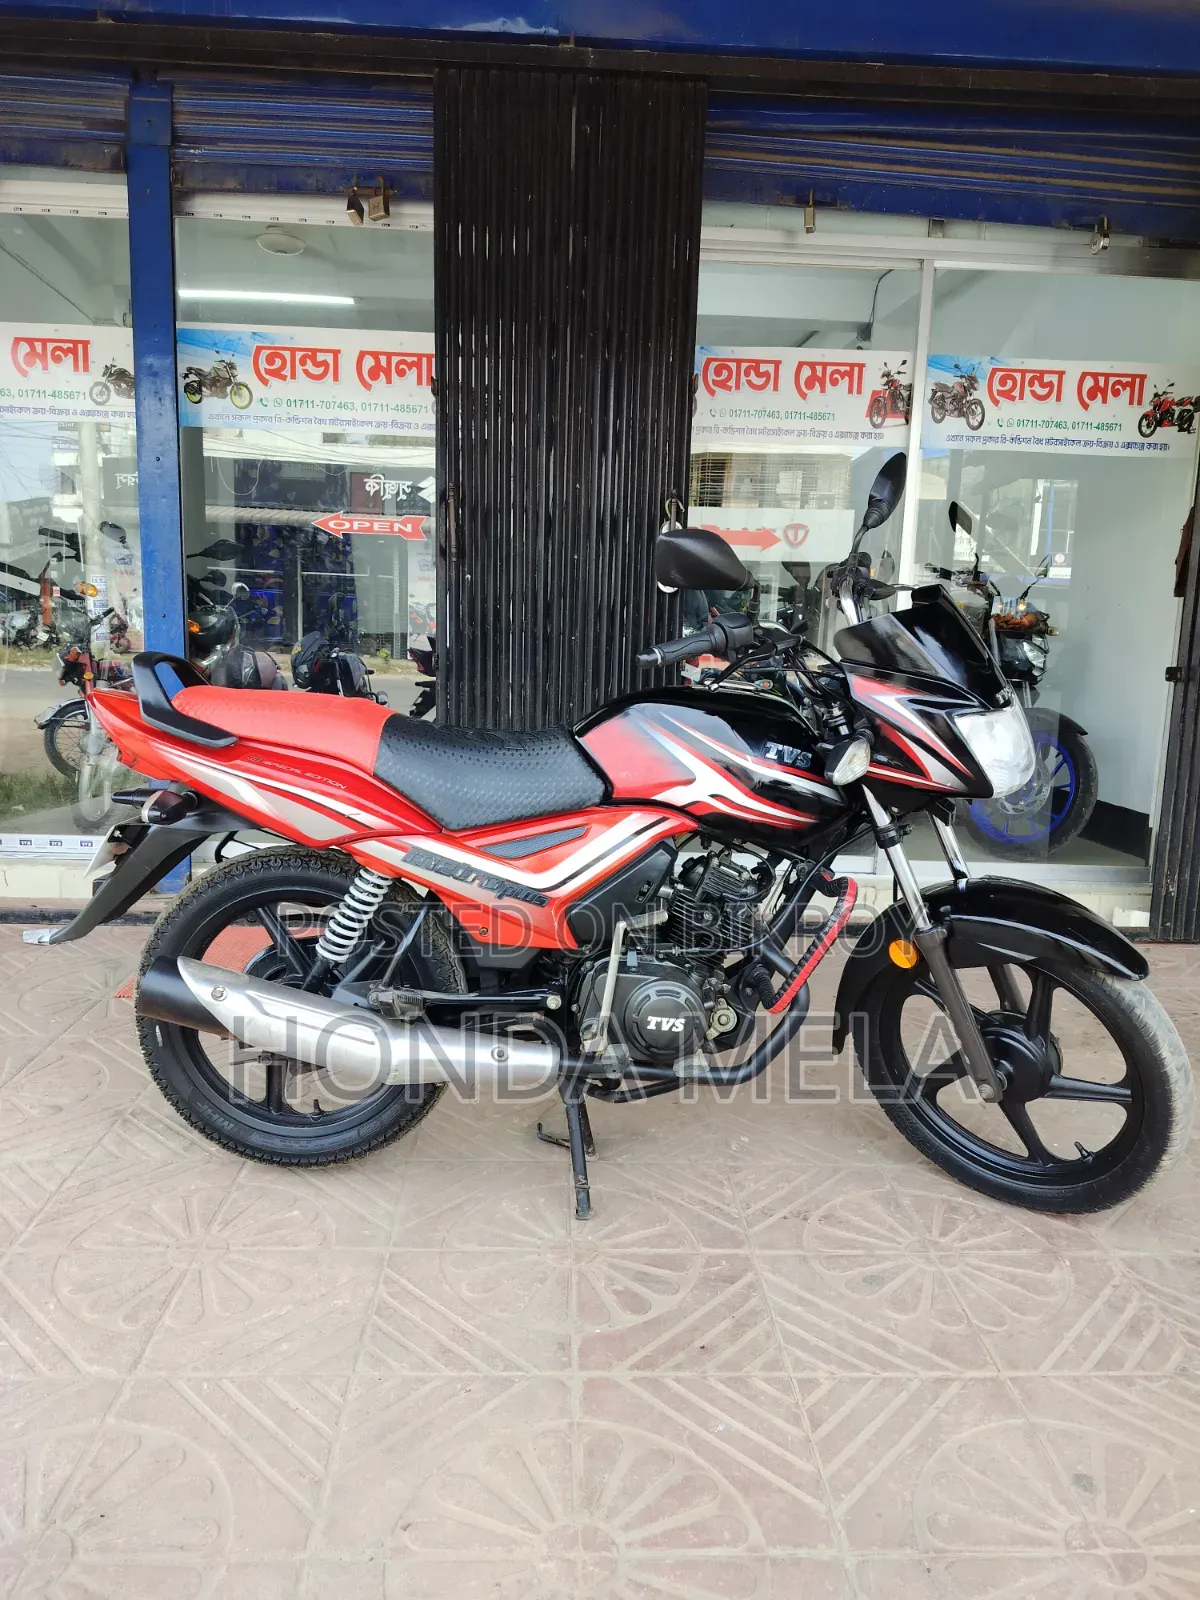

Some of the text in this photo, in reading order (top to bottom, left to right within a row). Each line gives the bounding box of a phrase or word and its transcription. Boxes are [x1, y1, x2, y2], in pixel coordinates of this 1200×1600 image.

[11, 336, 91, 379] মেলা
[252, 344, 435, 392] হোন্ডা মেলা
[702, 356, 866, 401] হোন্ডা মেলা
[18, 388, 87, 401] 01711-485671
[986, 367, 1148, 412] হোন্ডা মেলা
[286, 398, 428, 414] 01711-707463, 01711-485671
[728, 408, 835, 422] 01711-707463, 01711-485671
[1016, 418, 1122, 432] 01711-707463, 01711-485671
[327, 519, 414, 533] OPEN
[764, 740, 813, 768] TVS
[304, 772, 348, 790] EDITION
[646, 1015, 687, 1032] TVS
